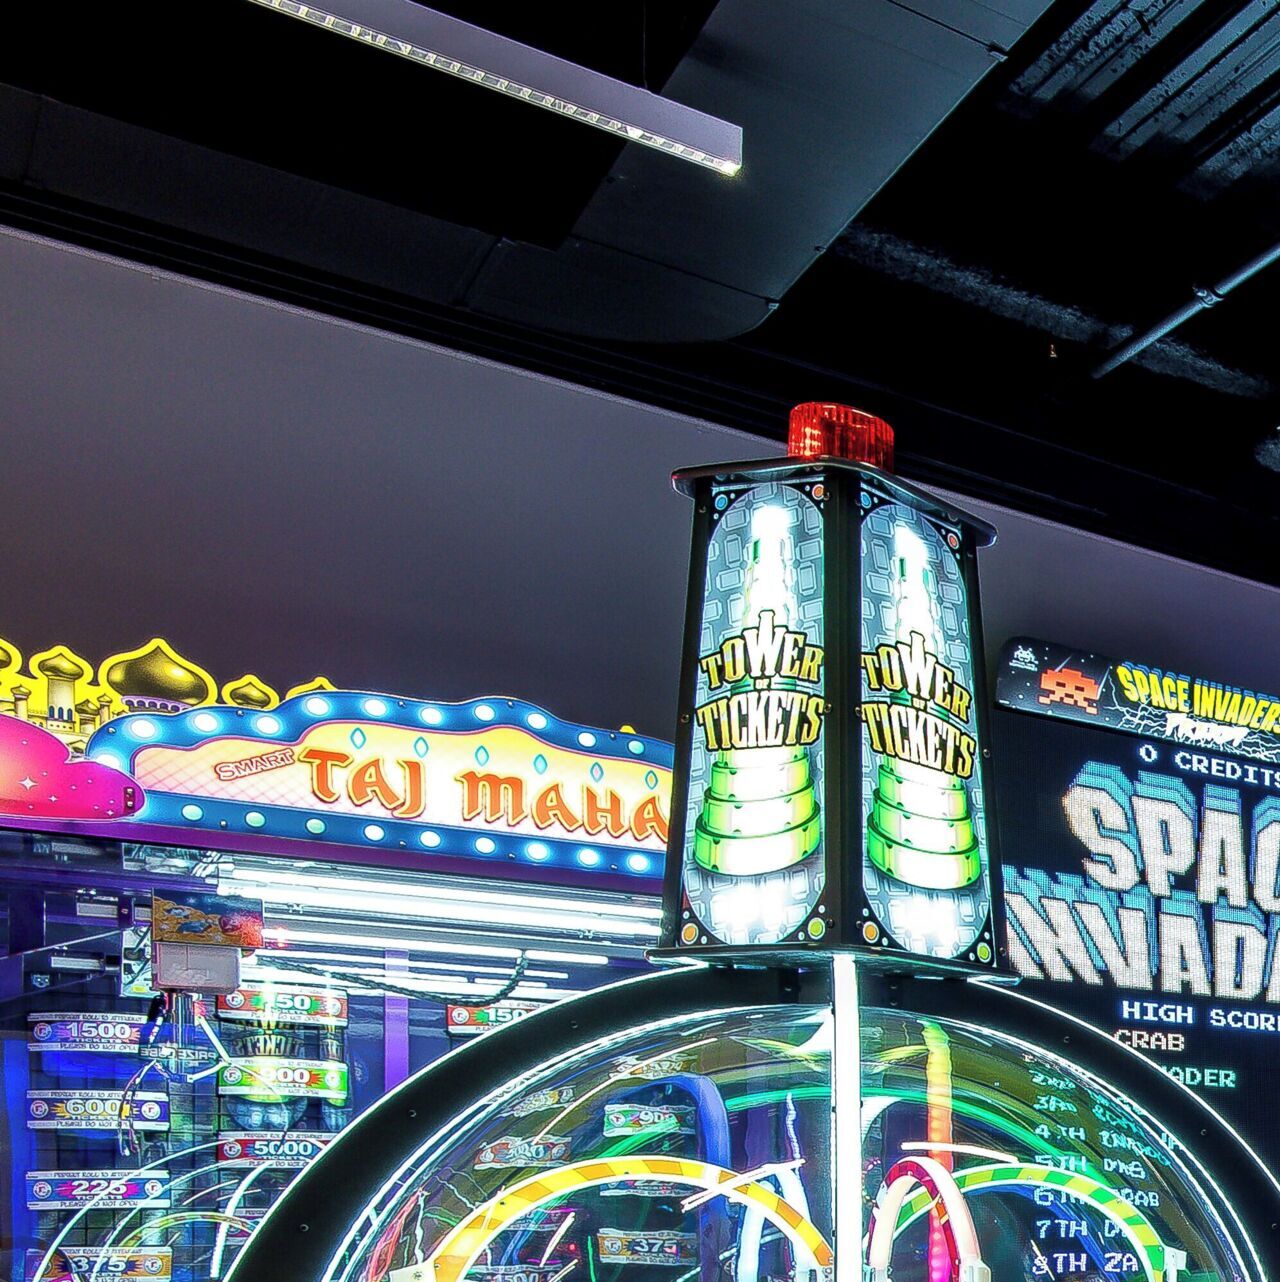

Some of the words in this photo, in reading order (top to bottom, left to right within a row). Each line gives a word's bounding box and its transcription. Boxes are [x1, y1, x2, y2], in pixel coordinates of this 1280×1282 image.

[699, 610, 825, 690] TOWER
[861, 632, 973, 724] TOWER
[1117, 661, 1190, 712] SPACE
[696, 690, 825, 752] TICKETS
[861, 701, 976, 779] TICKETS
[1139, 744, 1157, 762] 0
[214, 748, 295, 782] SMART
[299, 747, 427, 820] TAJ
[455, 769, 668, 842] MAHA
[486, 1006, 523, 1023] 150
[1122, 1000, 1194, 1025] HIGH
[66, 1022, 132, 1039] 1500
[1114, 1030, 1185, 1051] CRAB
[1161, 1066, 1236, 1088] ADER
[65, 1099, 121, 1116] 600
[253, 1140, 313, 1156] 5000
[71, 1179, 128, 1195] 225
[1036, 1219, 1088, 1239] 7TH
[72, 1255, 127, 1272] 375
